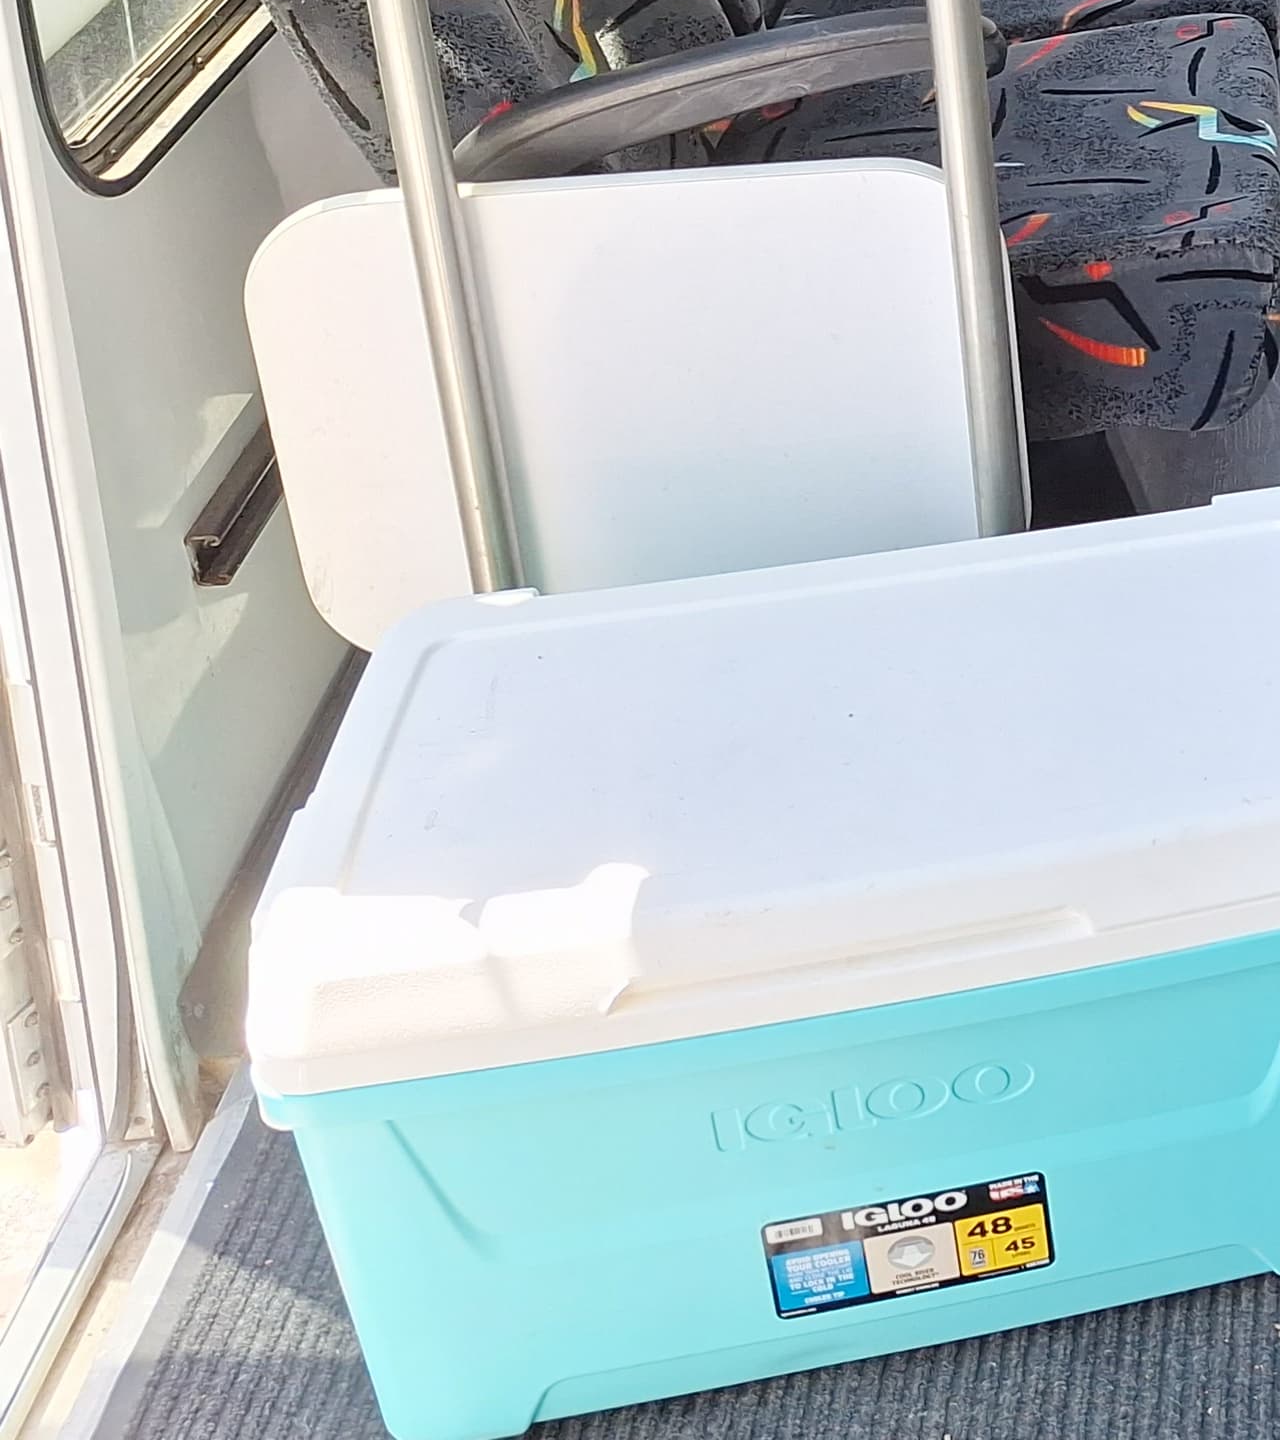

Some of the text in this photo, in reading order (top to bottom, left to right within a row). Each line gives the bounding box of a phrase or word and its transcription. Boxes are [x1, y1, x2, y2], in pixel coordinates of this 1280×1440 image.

[710, 1060, 1036, 1153] IGLOO
[841, 1190, 968, 1231] IGLOO
[967, 1216, 1013, 1238] 48
[971, 1249, 985, 1261] 76
[1004, 1236, 1036, 1252] 45
